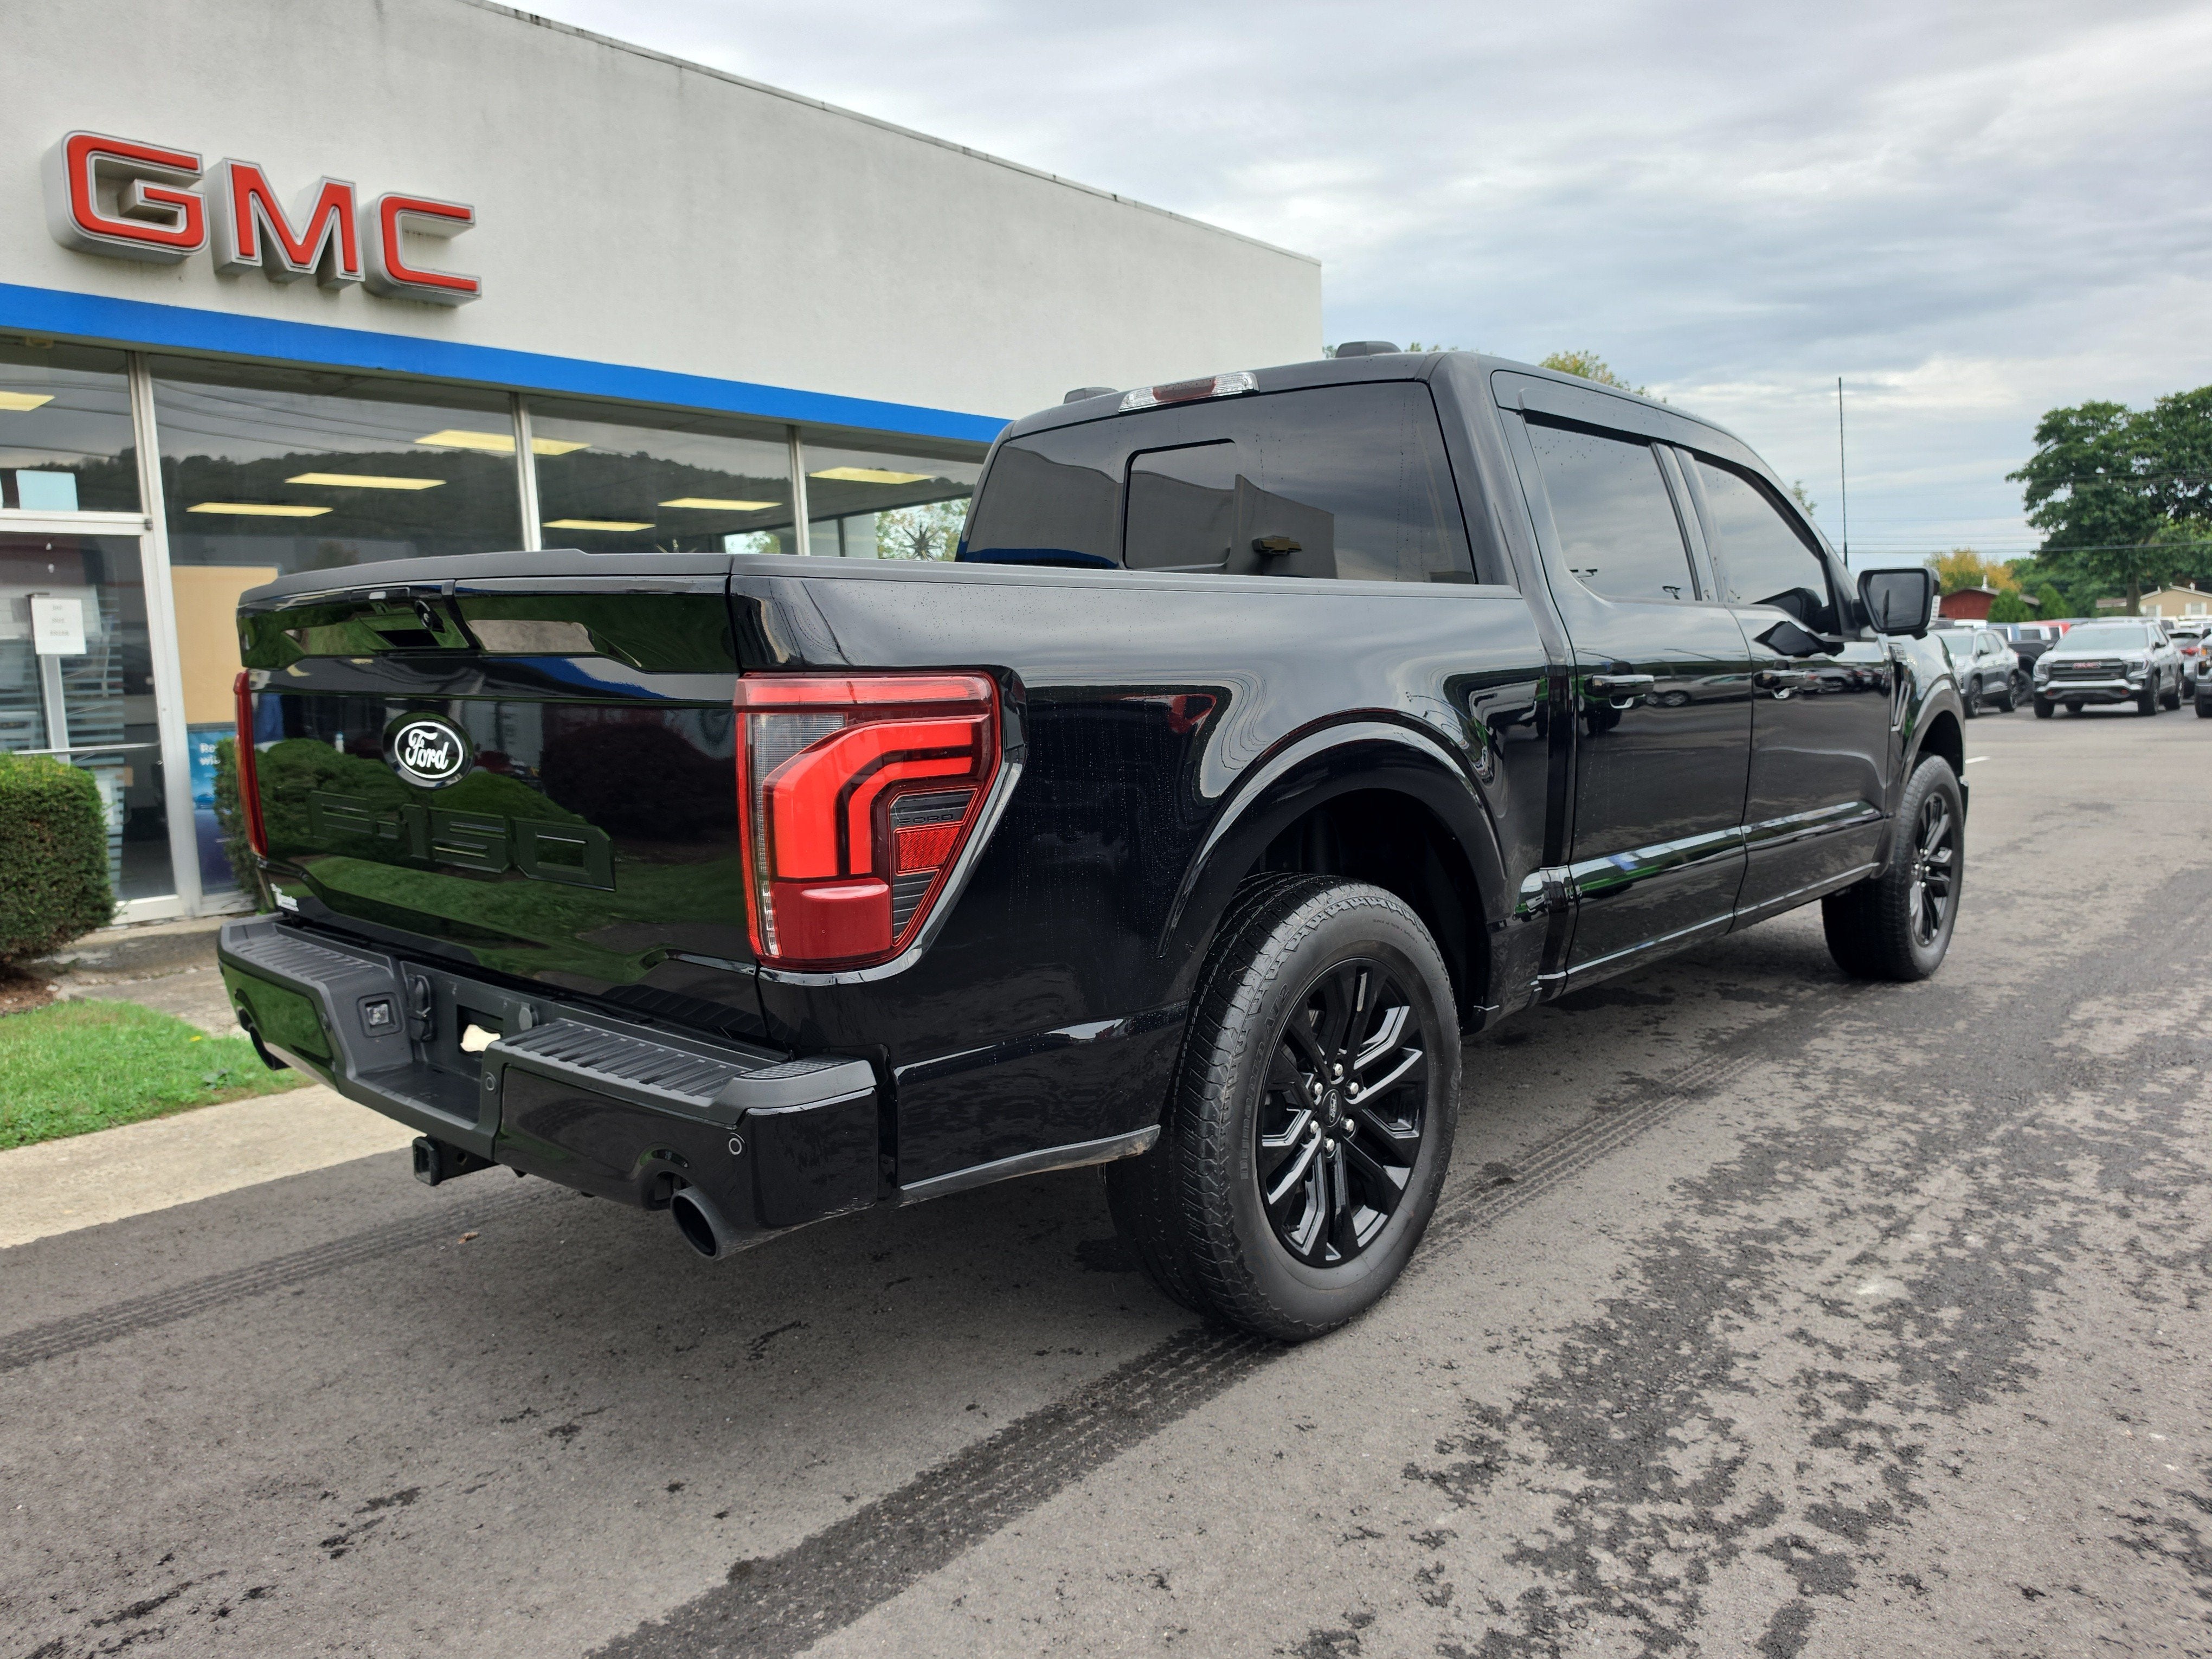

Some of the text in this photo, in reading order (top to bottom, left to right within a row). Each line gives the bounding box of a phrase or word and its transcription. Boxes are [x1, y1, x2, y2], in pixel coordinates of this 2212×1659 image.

[61, 130, 482, 300] GMC
[405, 729, 449, 769] Ford
[309, 790, 616, 892] F-150
[897, 814, 954, 826] FORD
